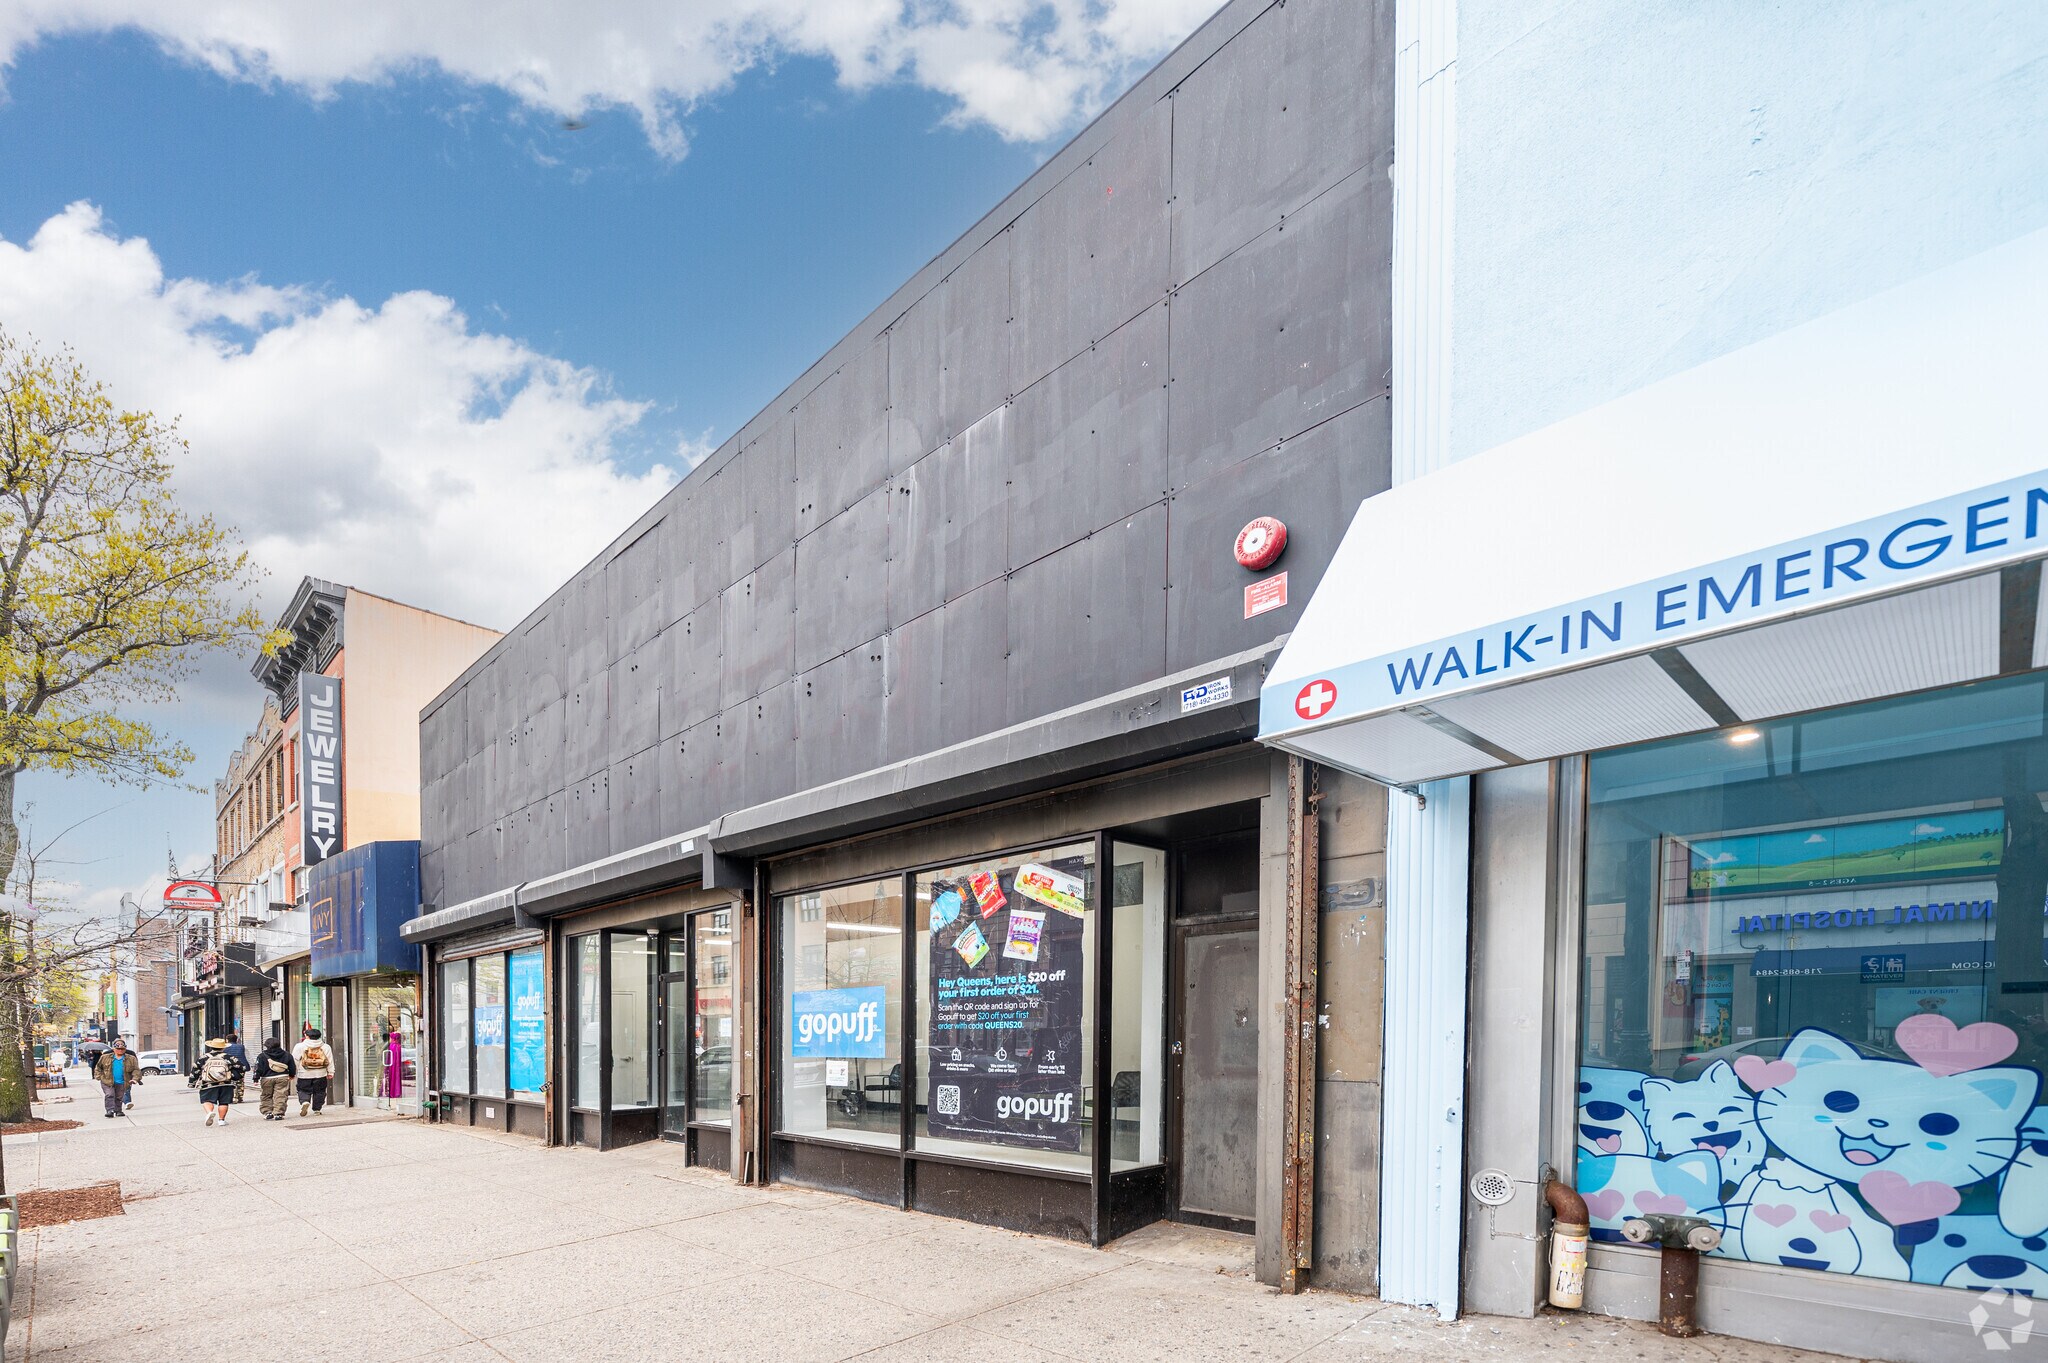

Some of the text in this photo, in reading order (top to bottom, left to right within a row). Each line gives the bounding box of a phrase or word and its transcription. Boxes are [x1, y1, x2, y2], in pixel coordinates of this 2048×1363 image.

[1386, 601, 1623, 696] WALK-IN
[1199, 691, 1229, 705] 492-4330
[1208, 684, 1229, 695] WORKS
[306, 685, 338, 859] JEWELRY
[938, 970, 1066, 990] Hey Queens, here is $20 off
[517, 991, 541, 1011] gopuff
[938, 983, 1040, 1000] your first order of $21.
[938, 1000, 1039, 1012] Scan the QR code and sign up for
[938, 1010, 1029, 1021] Gopuff to get $20 off your first
[477, 1013, 503, 1037] gopuff
[799, 1001, 878, 1043] gopuff
[938, 1021, 954, 1030] order
[968, 1021, 984, 1030] code
[984, 1020, 1024, 1030] QUEENS20.
[997, 1092, 1073, 1124] gopuff
